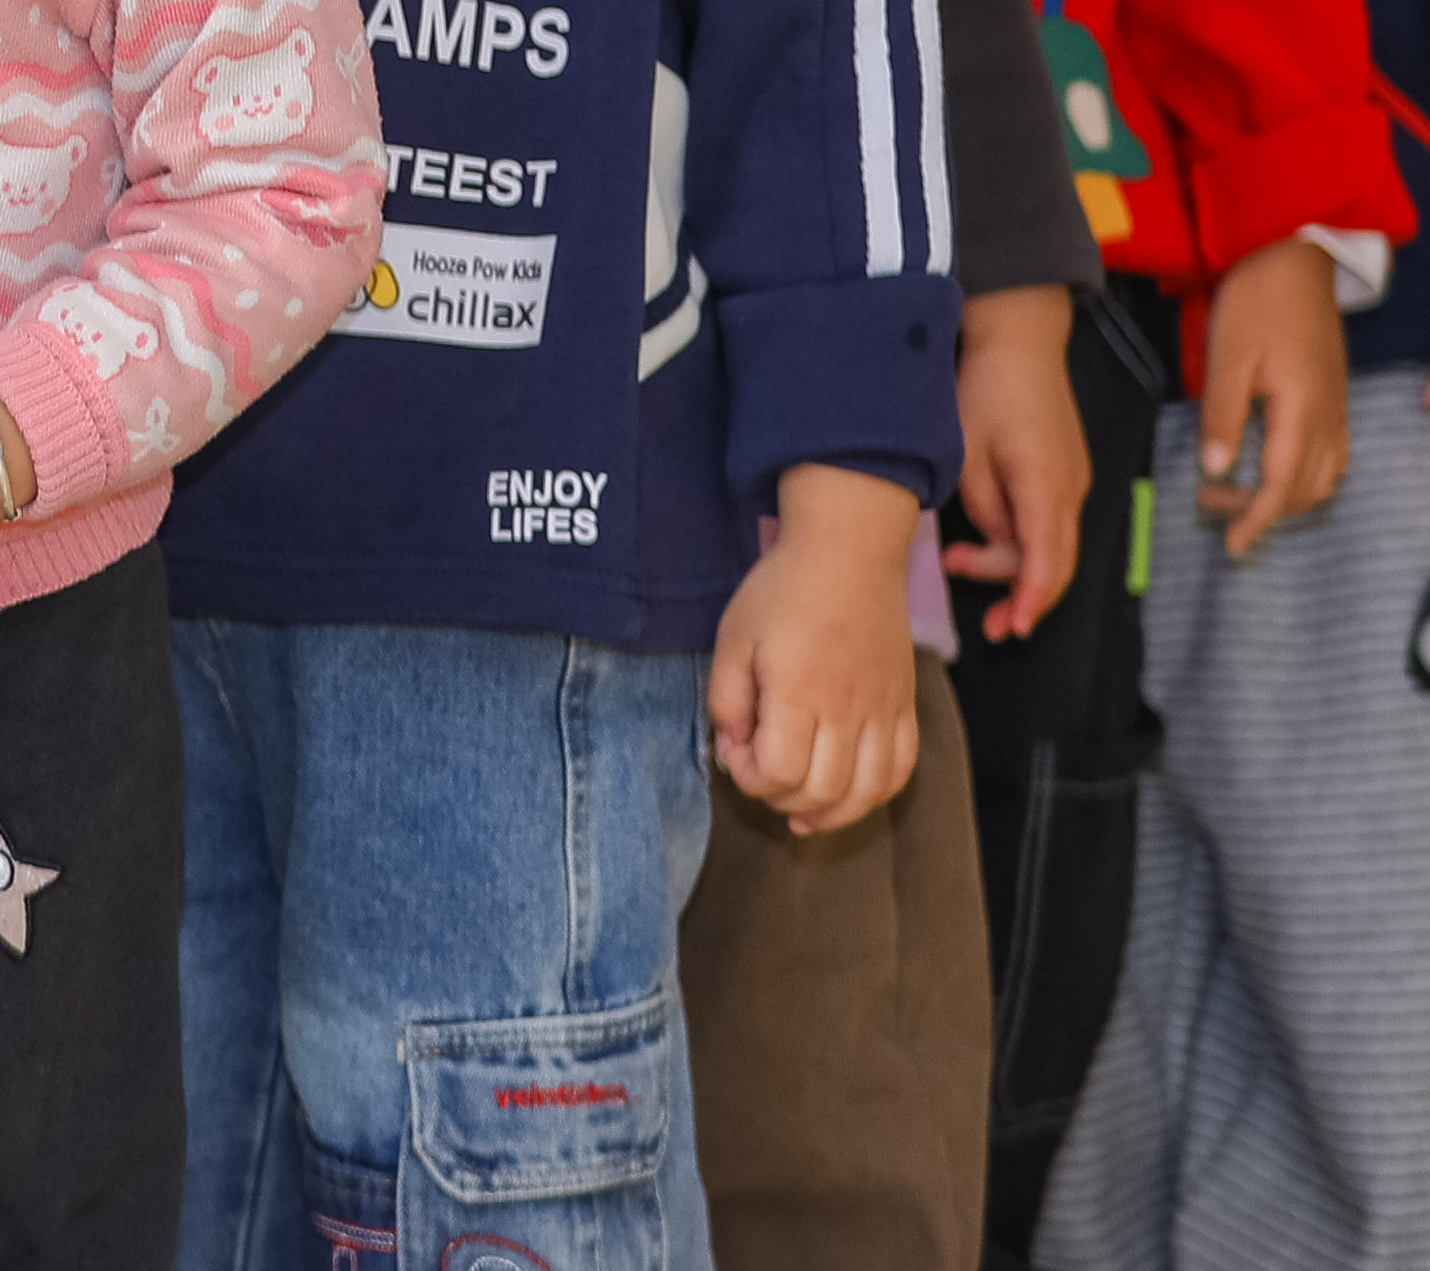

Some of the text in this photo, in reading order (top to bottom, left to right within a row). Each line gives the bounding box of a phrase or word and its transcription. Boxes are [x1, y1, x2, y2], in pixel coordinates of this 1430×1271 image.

[472, 255, 509, 281] Pow
[407, 285, 538, 329] chillax
[487, 468, 609, 509] ENJOY
[490, 507, 599, 546] LIFES
